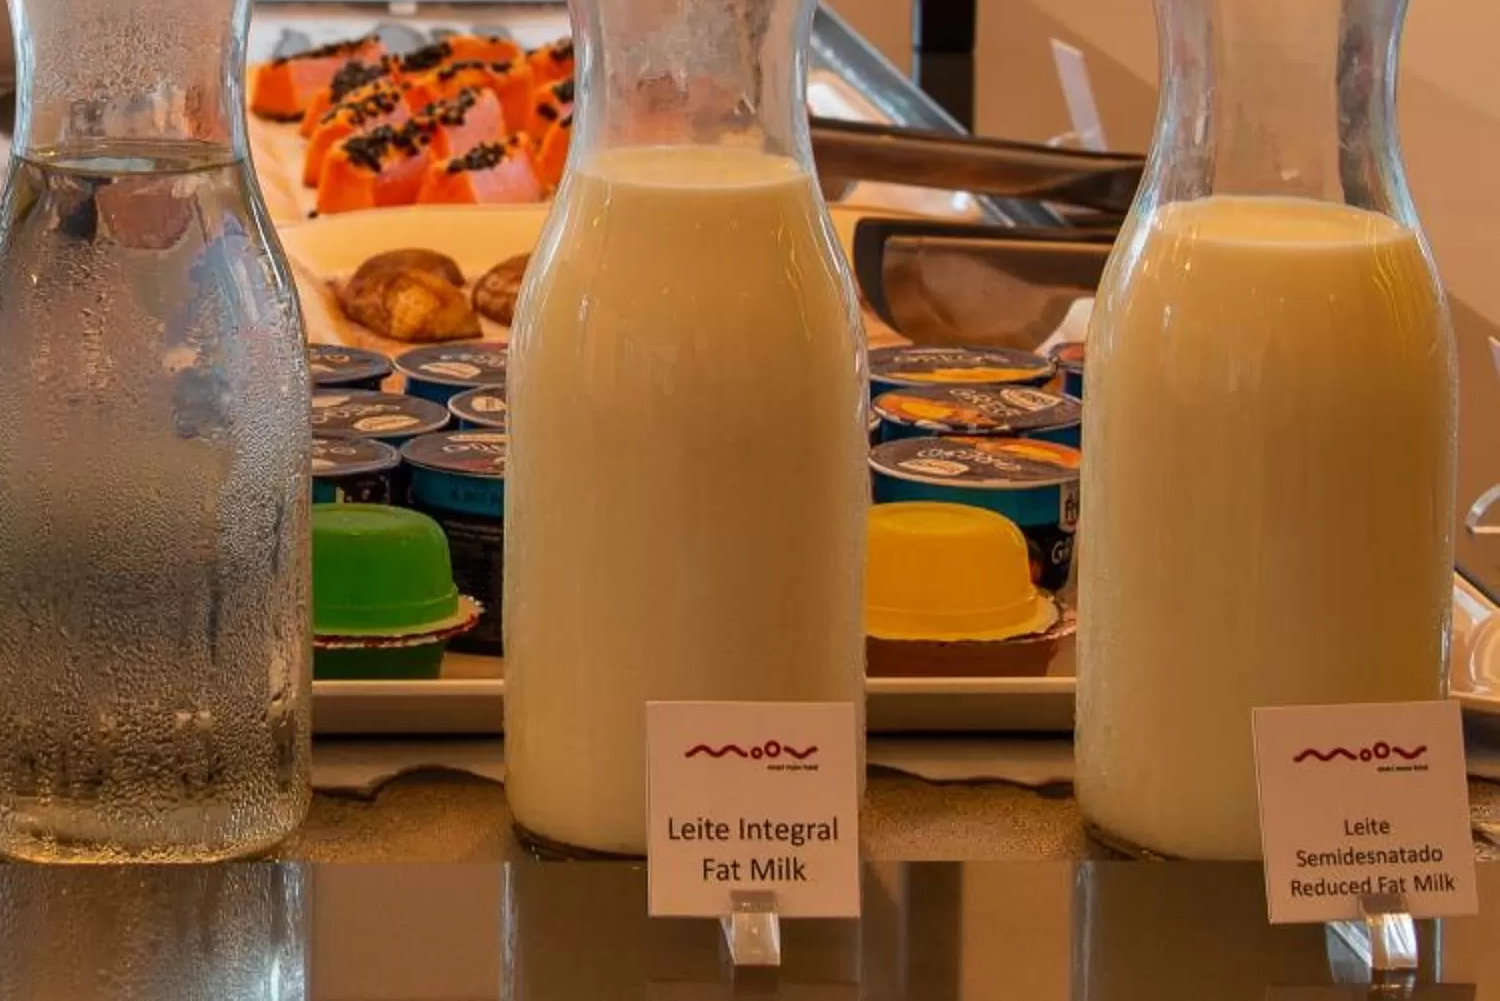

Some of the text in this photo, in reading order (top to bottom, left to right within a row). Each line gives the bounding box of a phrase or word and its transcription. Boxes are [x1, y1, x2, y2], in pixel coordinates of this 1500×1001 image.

[668, 817, 839, 847] Leite Integral
[1343, 817, 1392, 837] Leite
[1295, 845, 1444, 868] Semidesnatado
[702, 857, 807, 882] Fat Milk
[1290, 873, 1456, 897] Reduced Fat Milk
